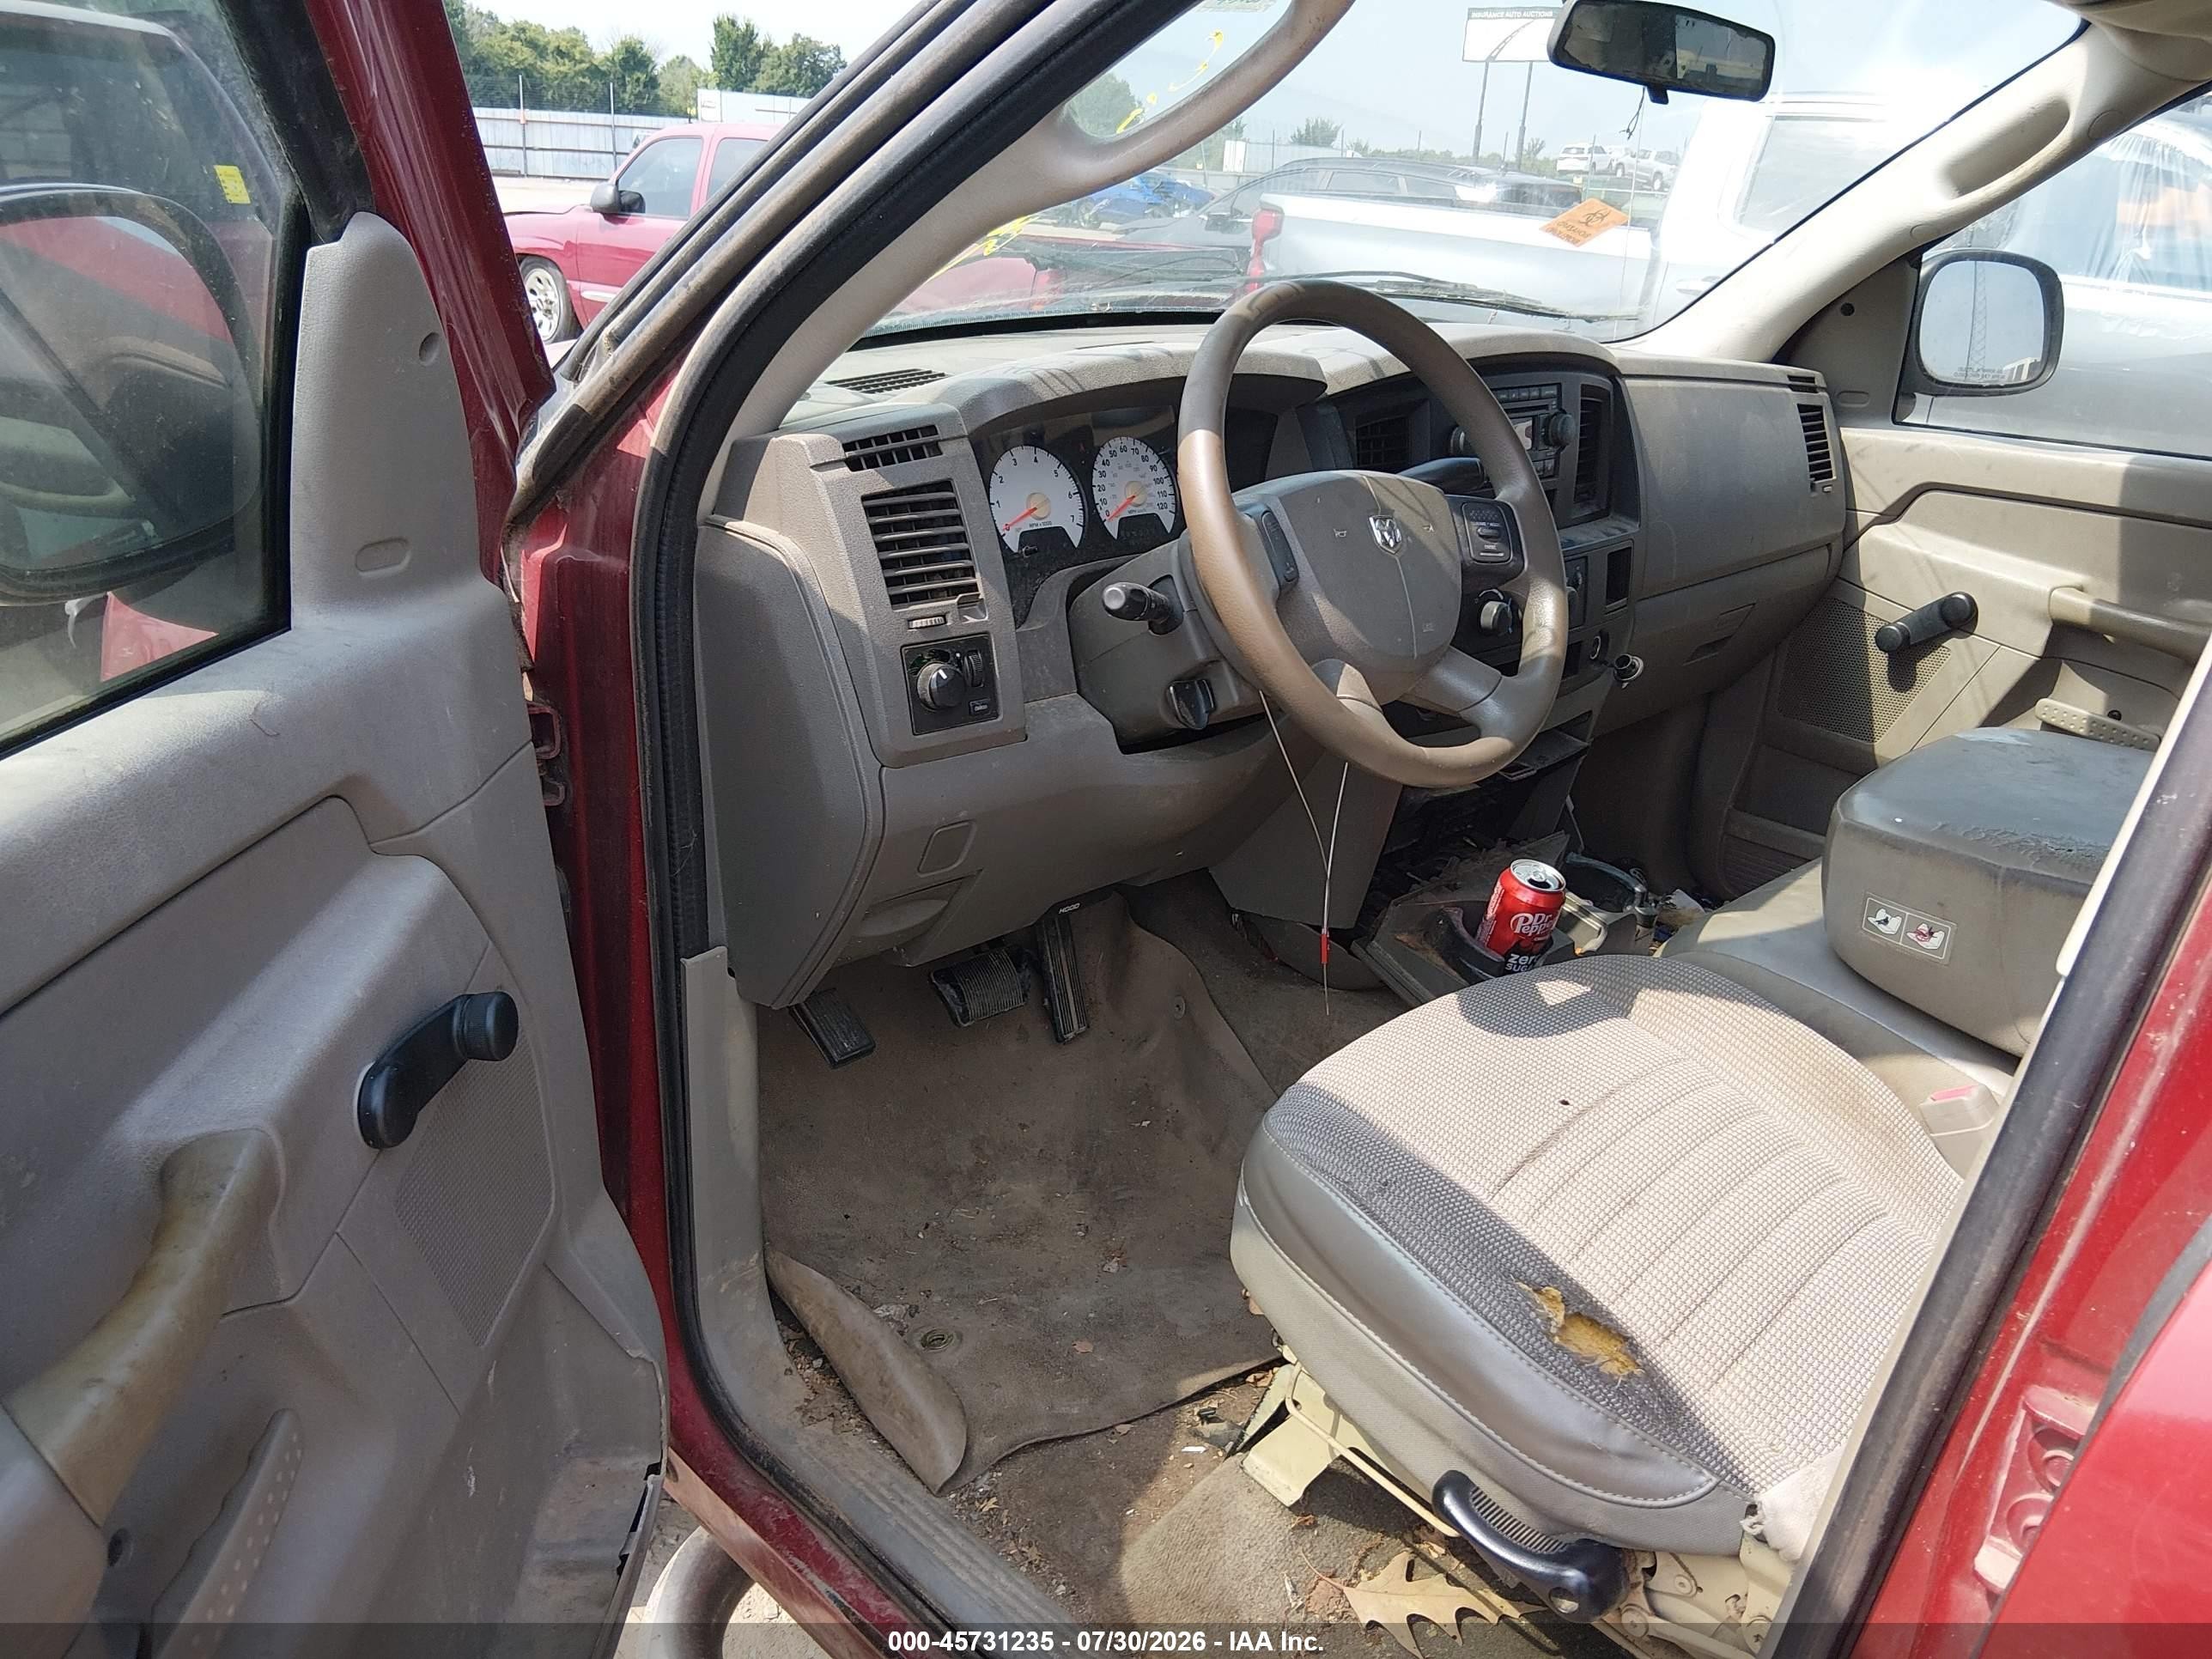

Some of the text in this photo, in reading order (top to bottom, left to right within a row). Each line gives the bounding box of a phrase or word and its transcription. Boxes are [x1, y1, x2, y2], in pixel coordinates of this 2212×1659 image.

[1098, 470, 1107, 478] 30
[1058, 902, 1080, 914] HOOD
[1533, 913, 1553, 926] Dr
